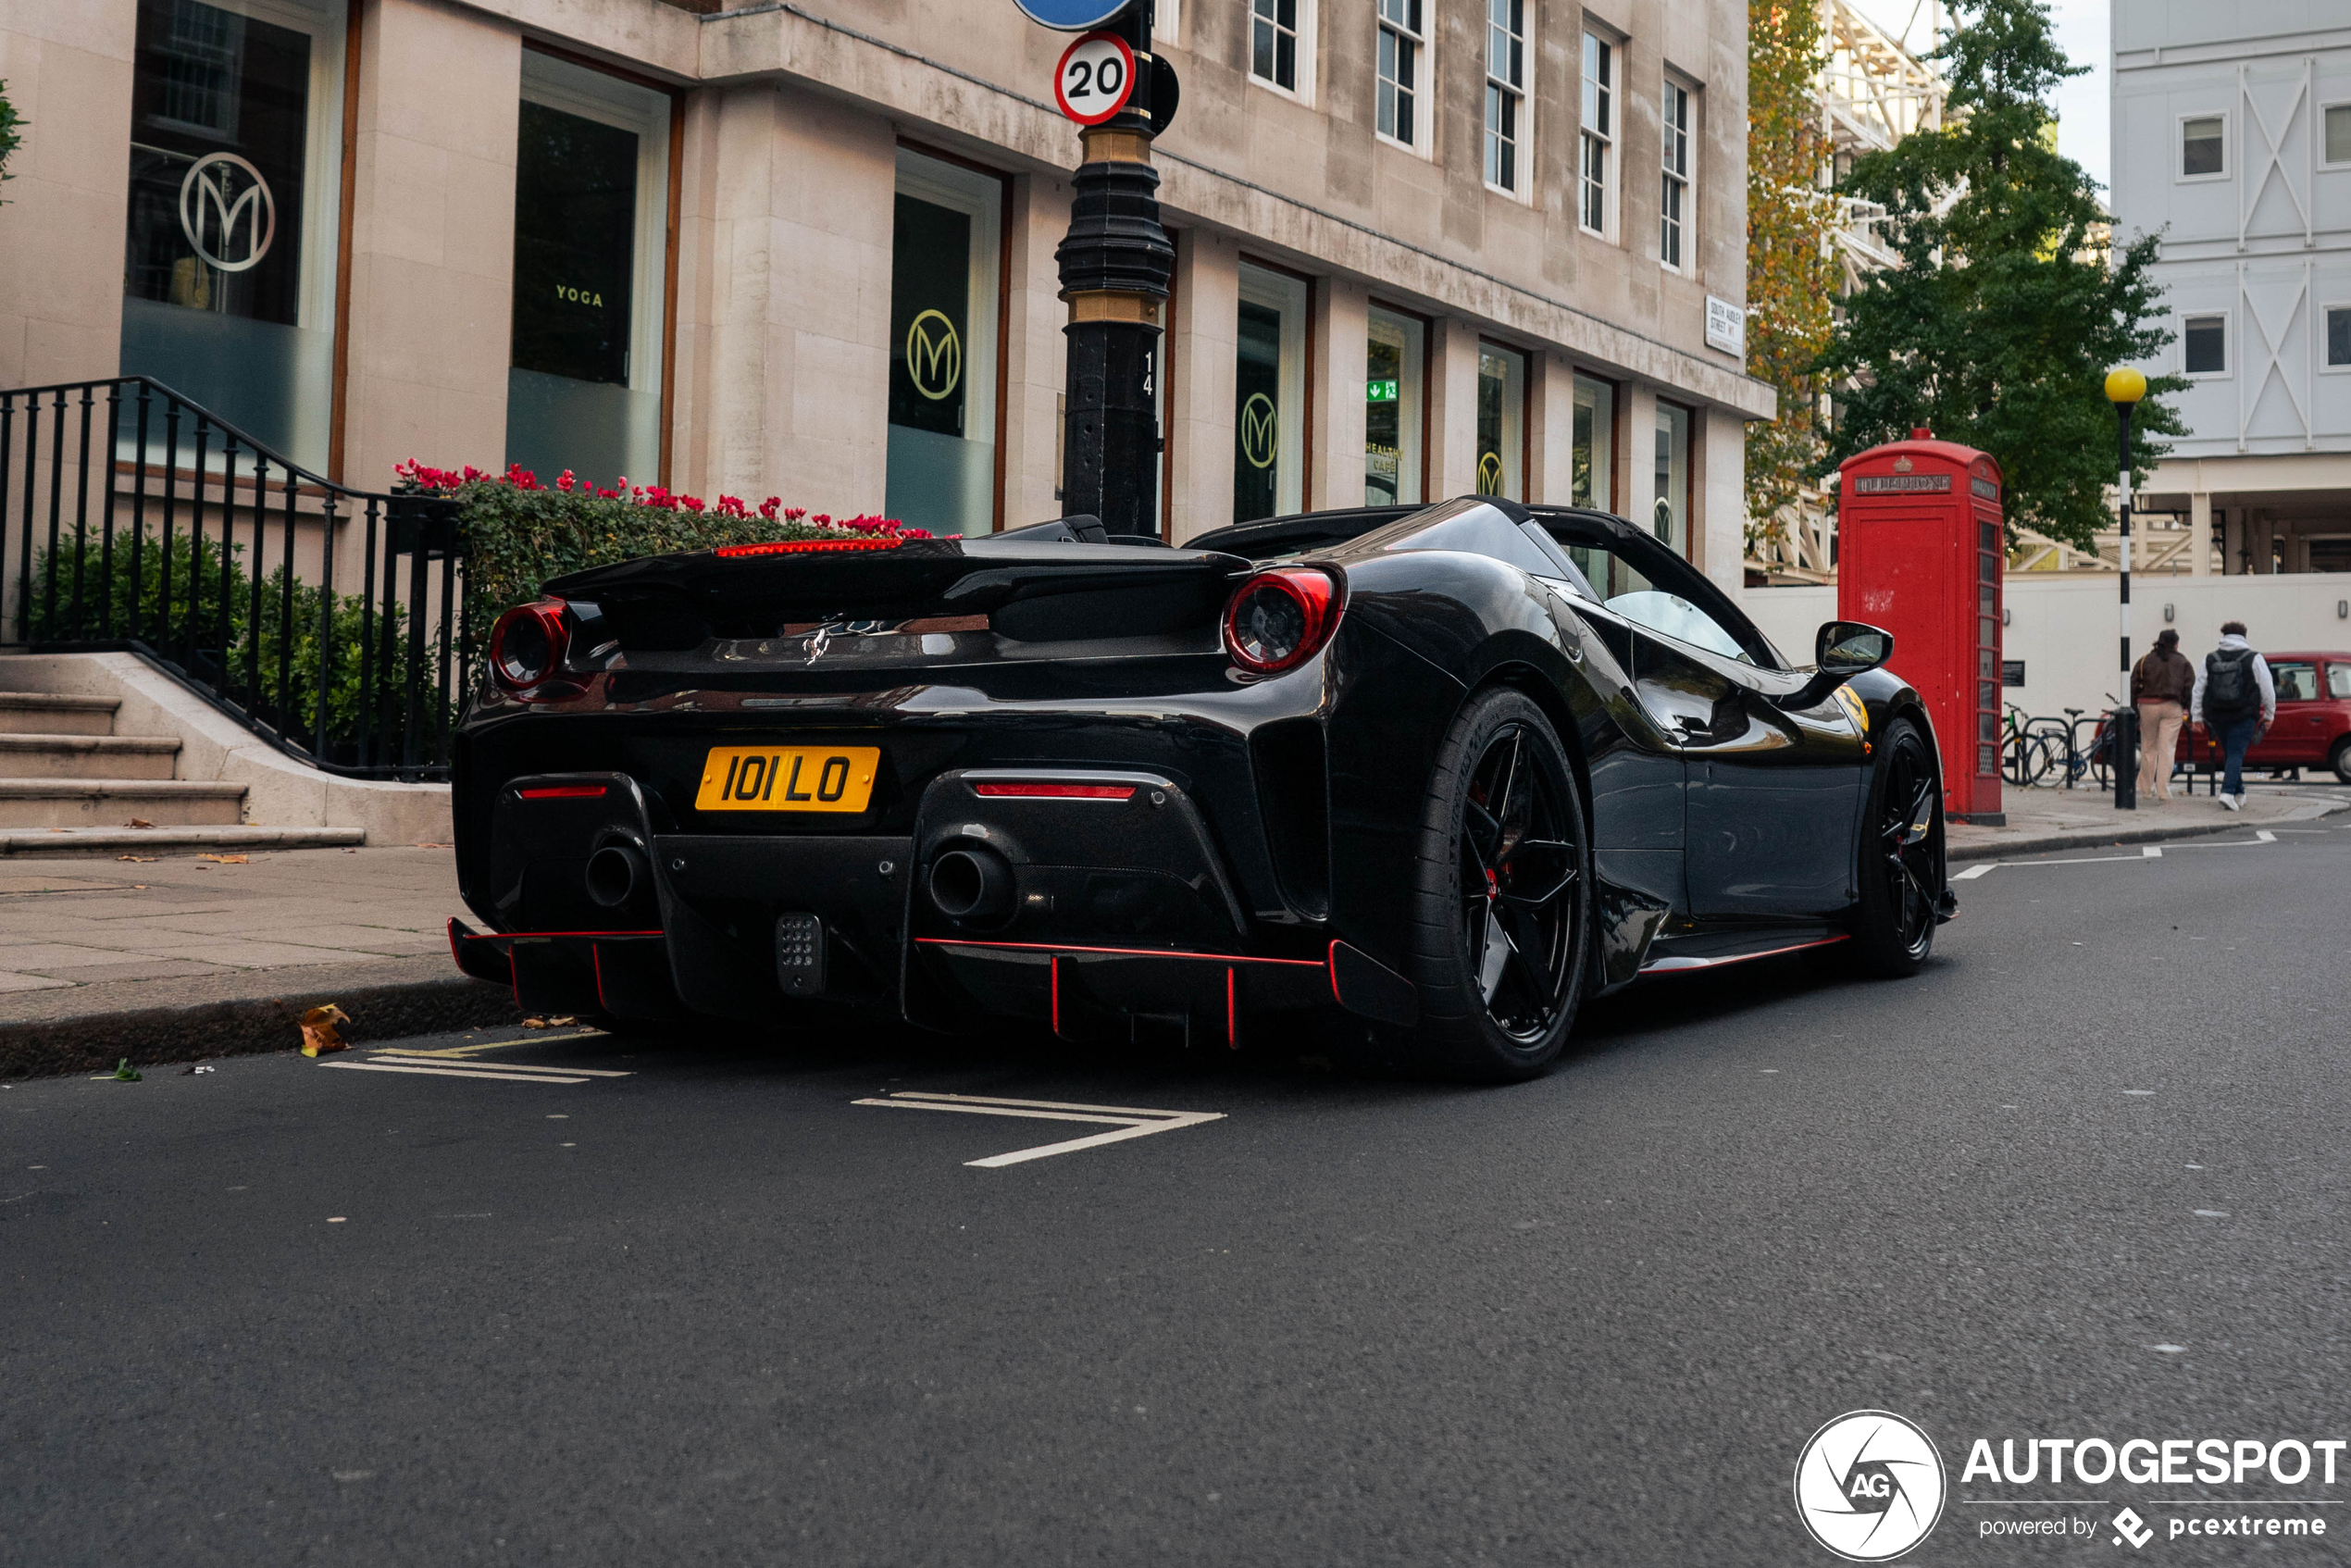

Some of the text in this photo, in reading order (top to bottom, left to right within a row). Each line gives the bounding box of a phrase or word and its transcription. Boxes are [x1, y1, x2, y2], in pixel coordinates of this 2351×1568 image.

[1068, 56, 1123, 98] 20
[192, 166, 264, 263] M
[556, 284, 603, 307] YOGA
[914, 321, 953, 392] M
[1246, 403, 1274, 462] M
[1365, 442, 1404, 461] HEALTHY
[1860, 476, 1951, 492] TELEPHONE
